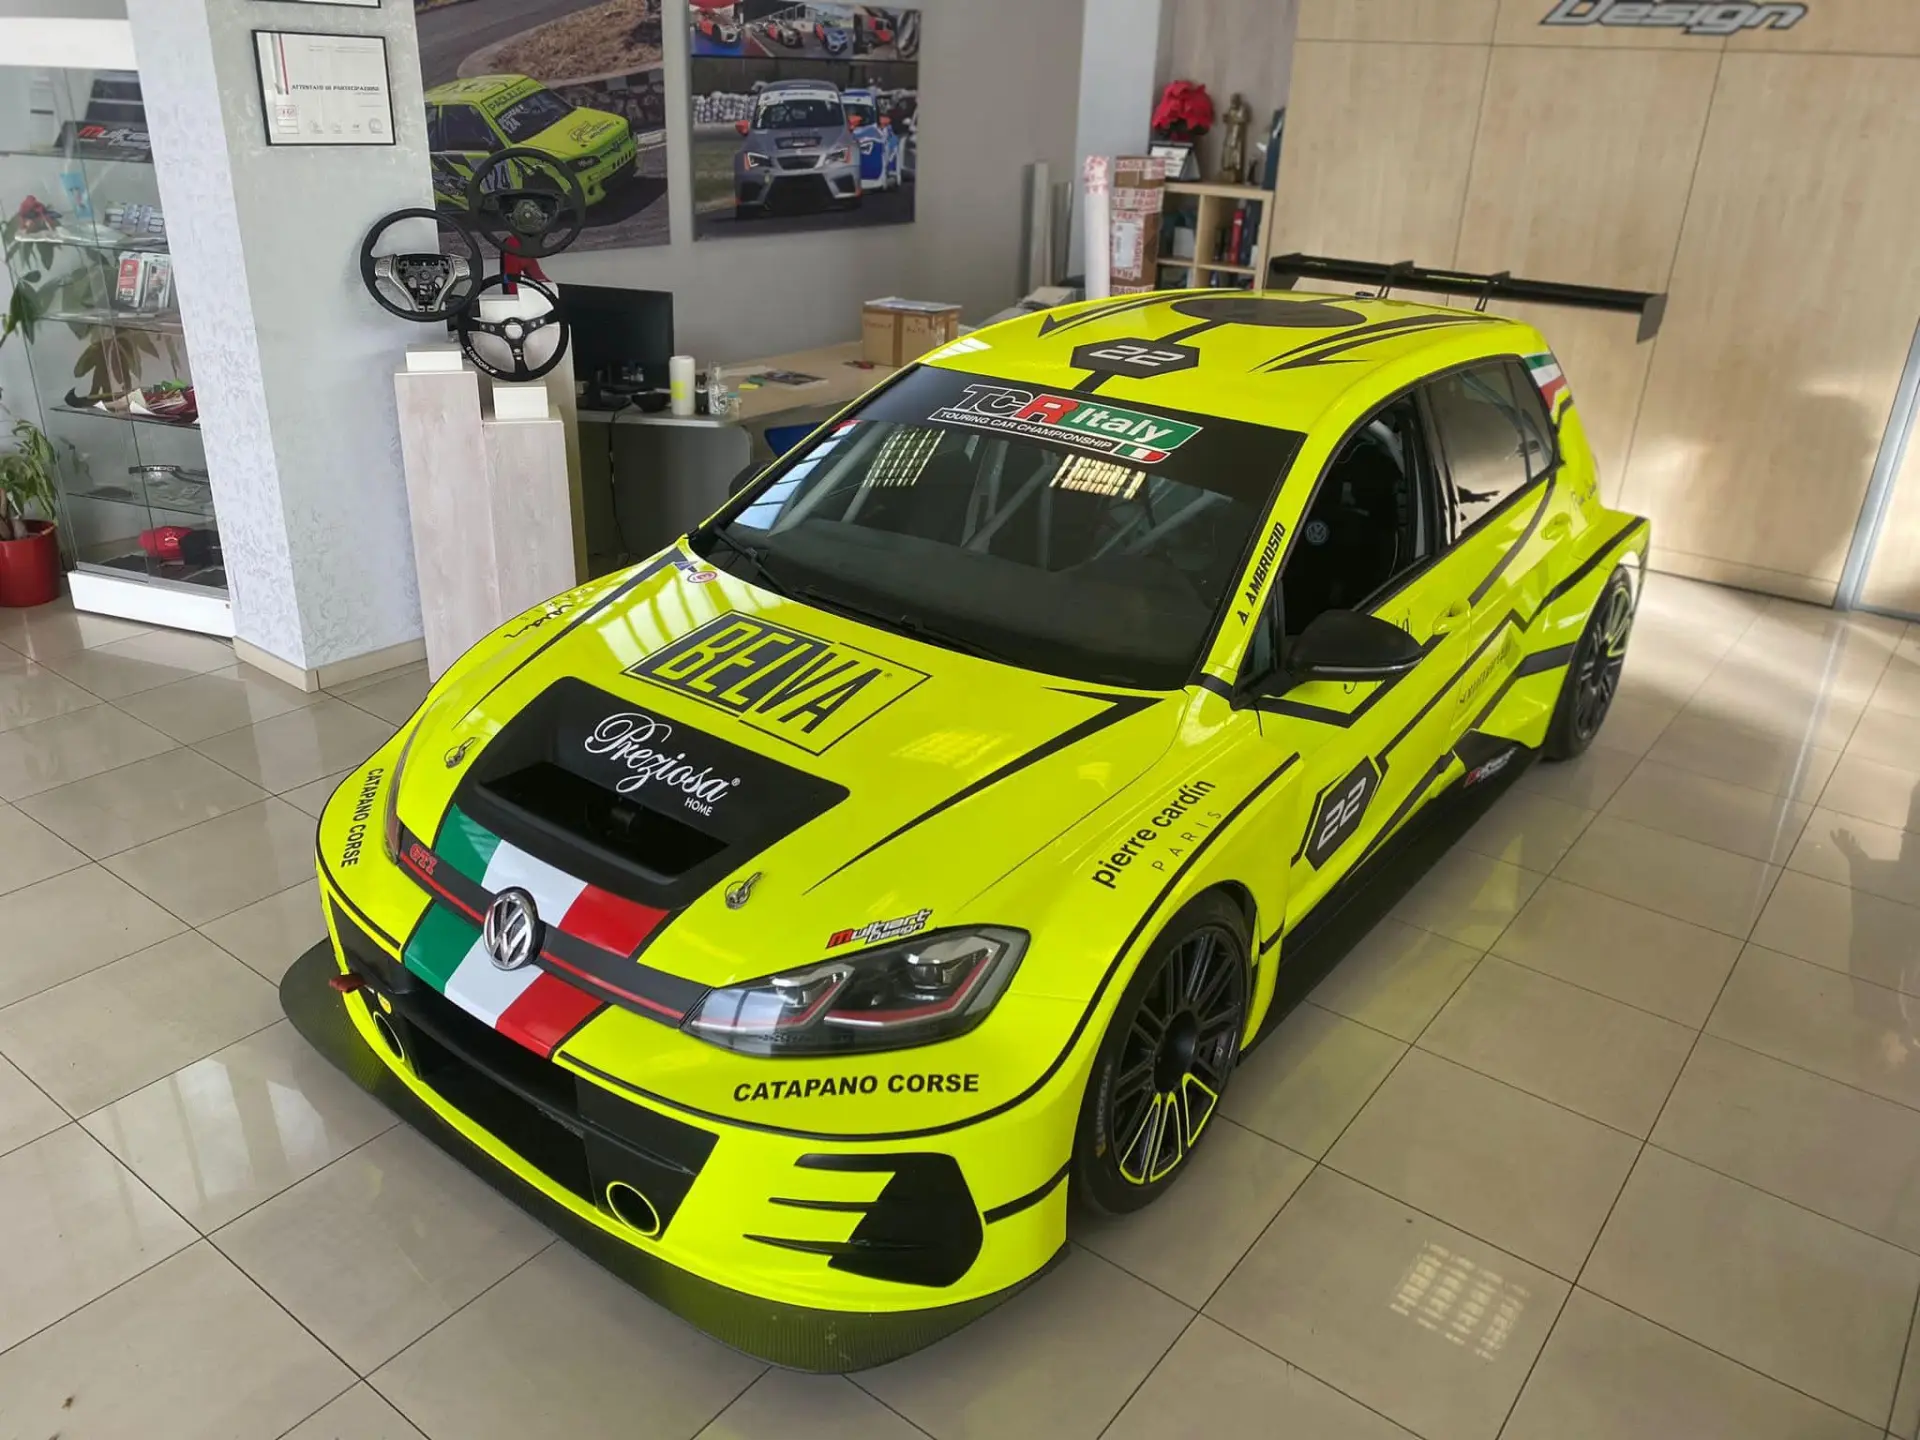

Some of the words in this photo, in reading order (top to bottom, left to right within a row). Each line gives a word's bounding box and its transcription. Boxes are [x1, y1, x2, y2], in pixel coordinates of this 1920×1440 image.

[1088, 344, 1186, 367] 22
[939, 411, 989, 426] TOURING
[990, 418, 1016, 430] CAR
[1016, 423, 1113, 449] CHAMPIONSHIP
[953, 383, 1079, 425] TCR
[1070, 406, 1174, 444] Italy
[1245, 521, 1286, 608] AMBROSIO
[651, 620, 883, 734] BELVA
[584, 712, 730, 803] Preziosa
[353, 768, 384, 822] CATAPANO
[684, 796, 714, 818] HOME
[1317, 776, 1367, 851] 22
[340, 824, 366, 868] CORSE
[409, 843, 438, 876] GTI
[1092, 827, 1157, 889] pierre
[1151, 780, 1216, 828] cardin
[1151, 811, 1222, 872] PARIS
[733, 1075, 878, 1102] CATAPANO
[887, 1073, 980, 1094] CORSE
